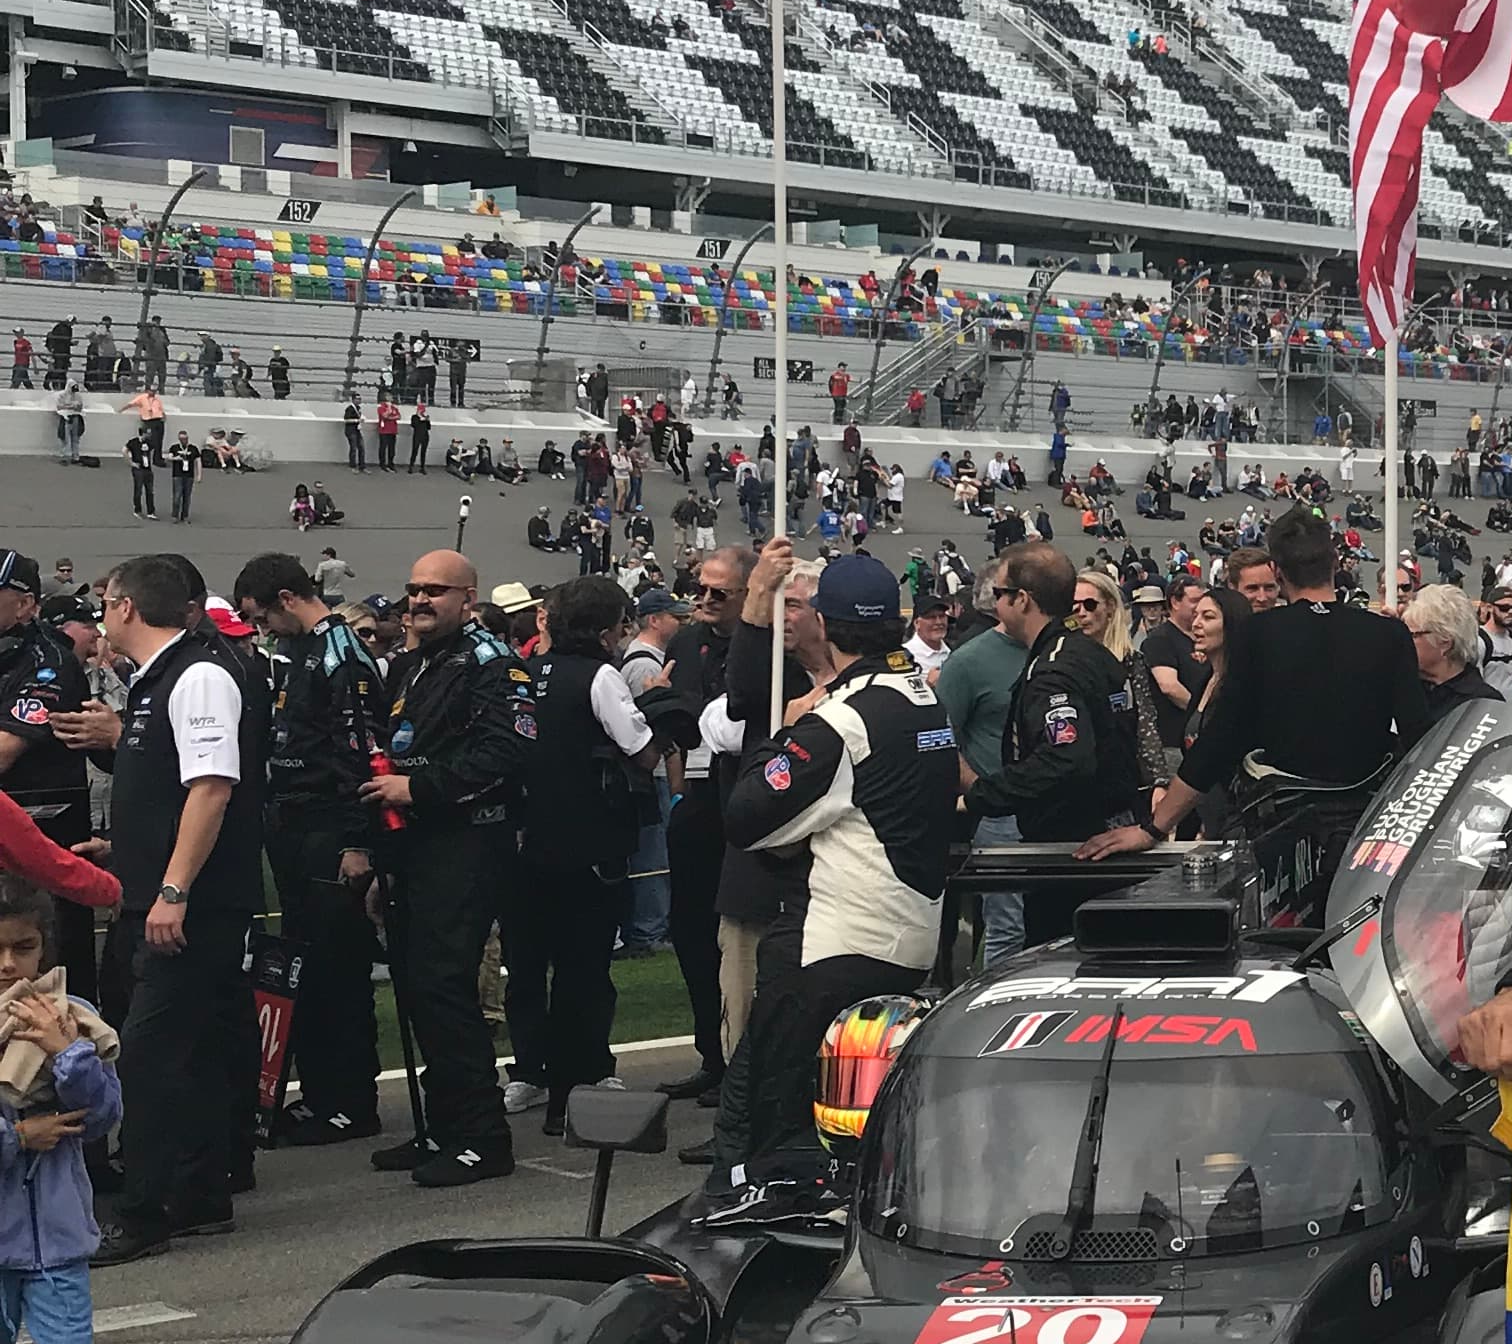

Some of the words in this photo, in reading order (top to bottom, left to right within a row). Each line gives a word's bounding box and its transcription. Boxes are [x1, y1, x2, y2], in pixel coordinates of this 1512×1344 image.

[288, 202, 310, 222] 152
[705, 241, 721, 258] 151
[16, 698, 43, 720] VP
[1388, 745, 1461, 842] GAUGHAN
[1398, 713, 1498, 848] DRUMWRIGHT
[1374, 769, 1428, 841] POPOW
[965, 970, 1308, 1012] BAR1
[1064, 1014, 1258, 1052] IMSA
[953, 1297, 1158, 1305] WeatherTech
